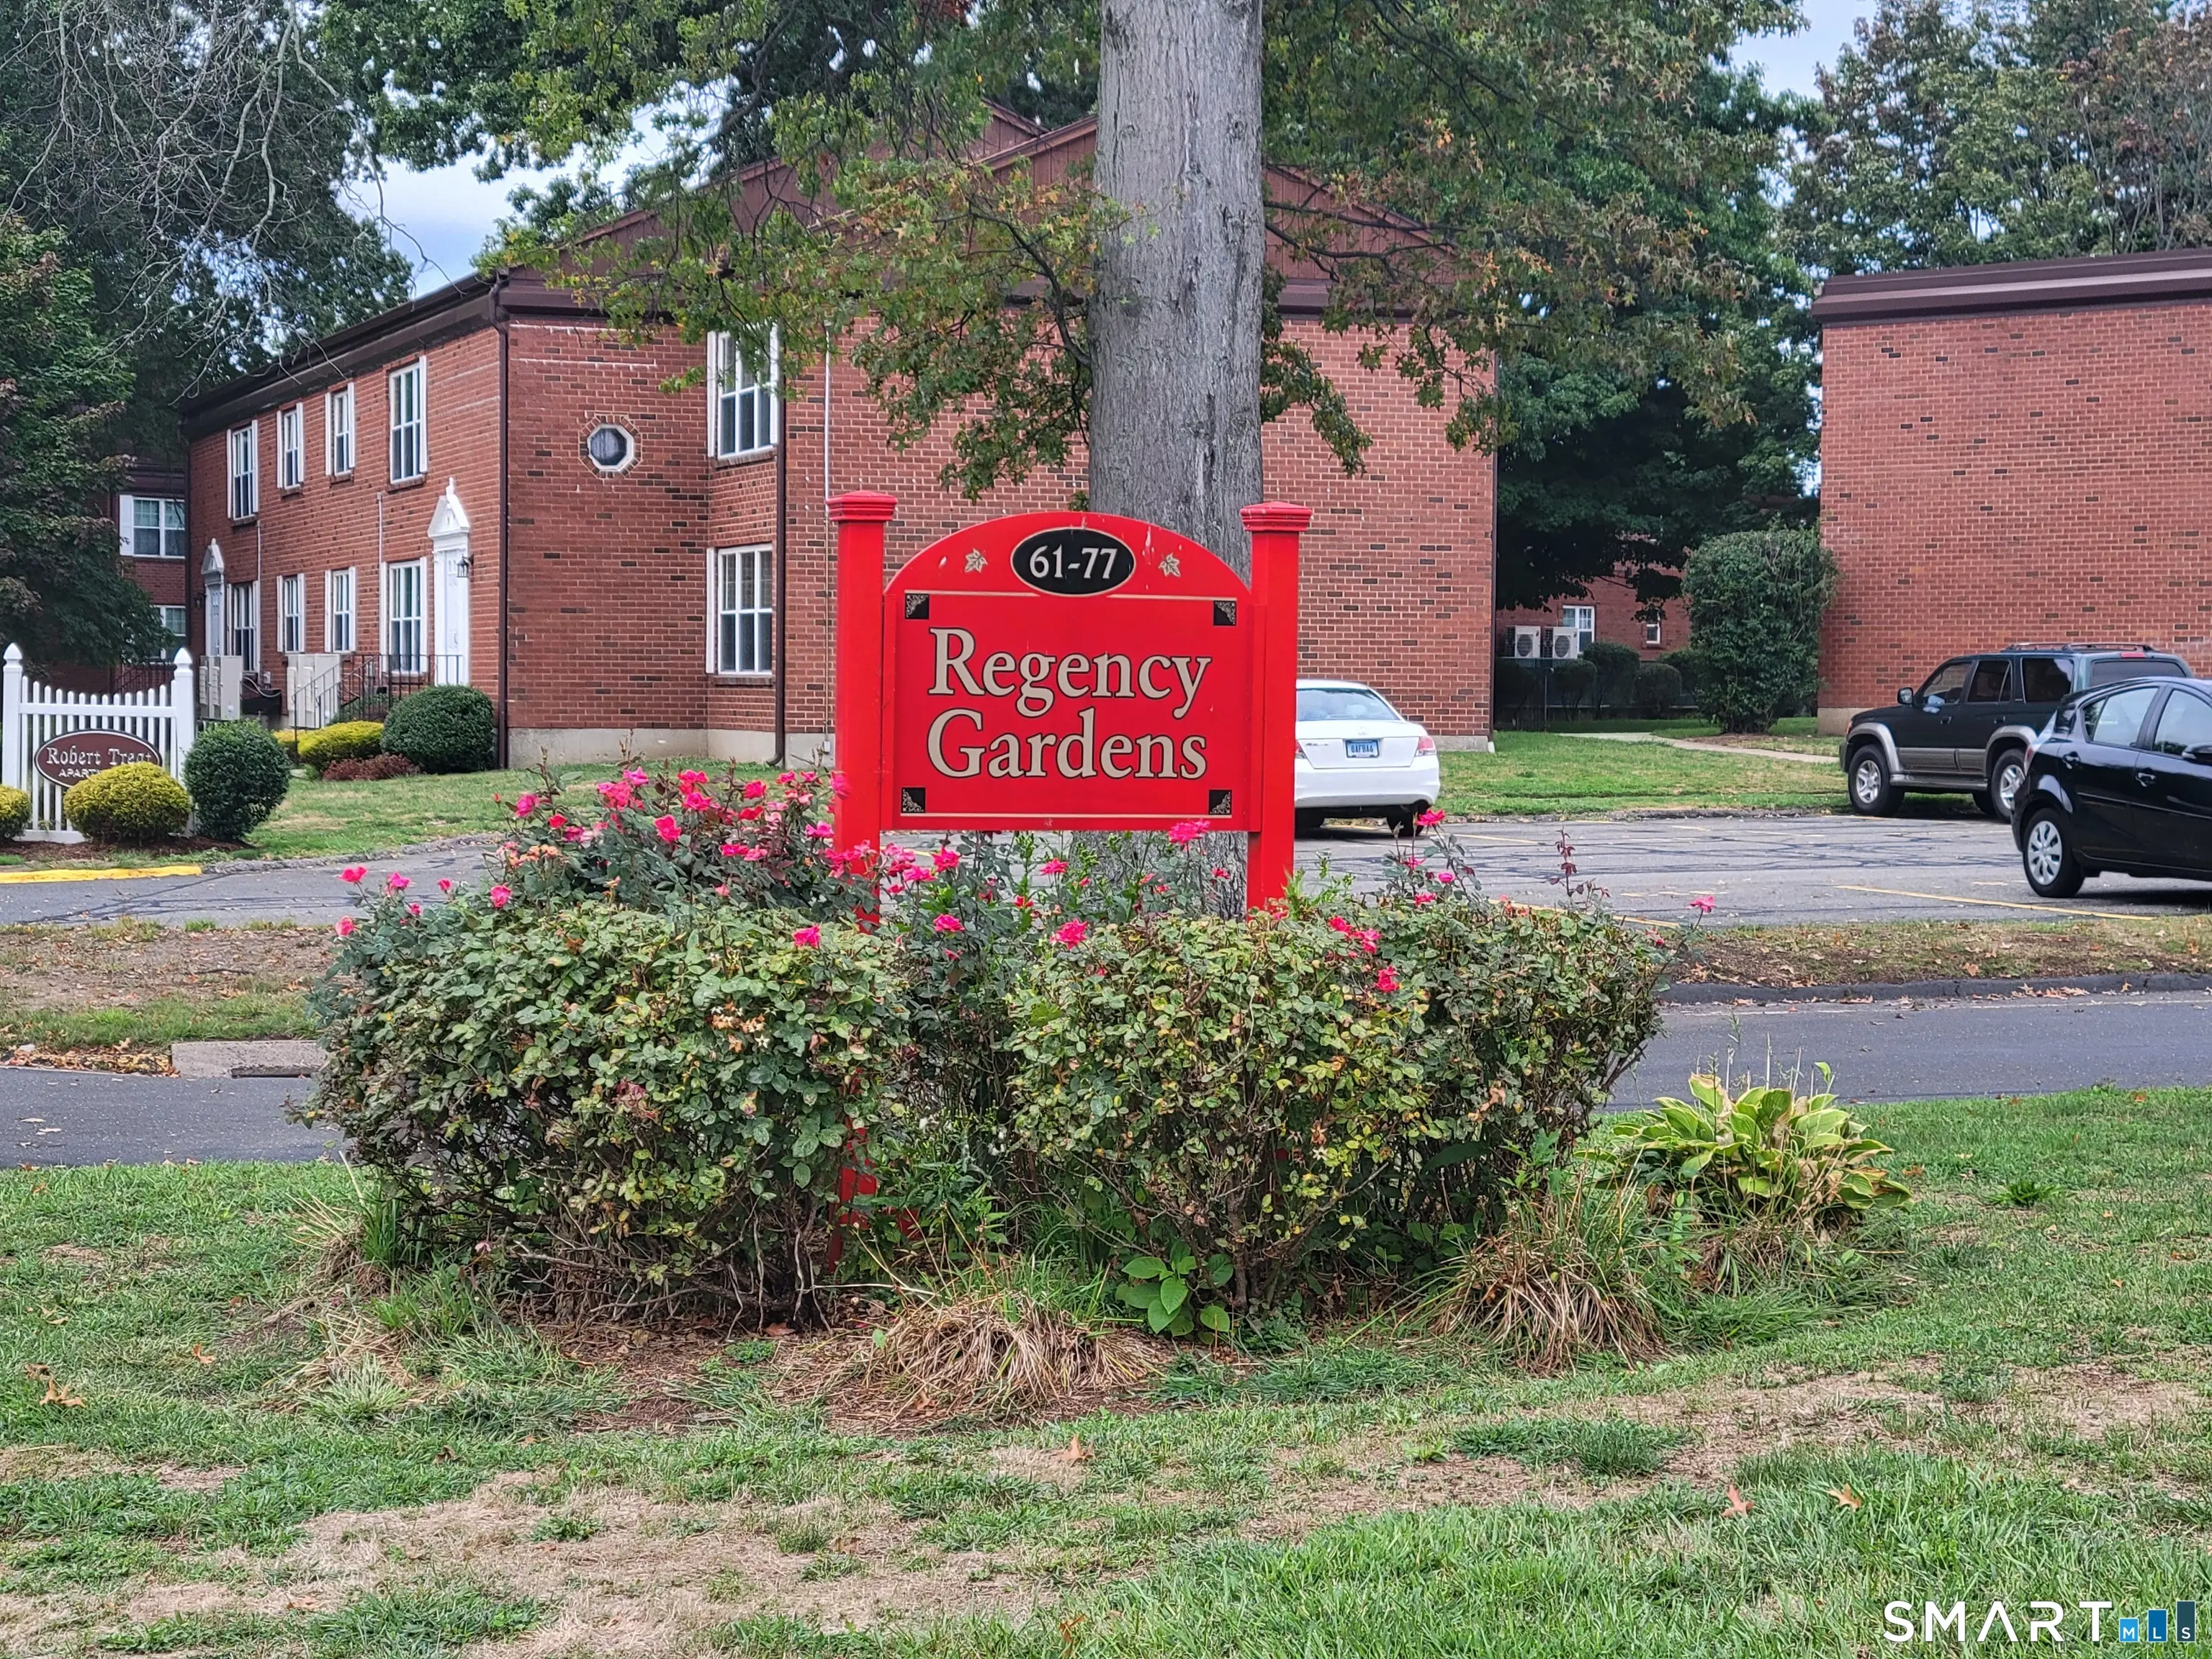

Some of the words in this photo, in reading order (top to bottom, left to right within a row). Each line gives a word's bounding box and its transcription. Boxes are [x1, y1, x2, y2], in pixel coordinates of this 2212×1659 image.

[1030, 544, 1118, 579] 61-77
[927, 626, 1211, 719] Regency
[46, 745, 102, 765] Robert
[926, 707, 1208, 779] Gardens
[58, 768, 101, 778] APART
